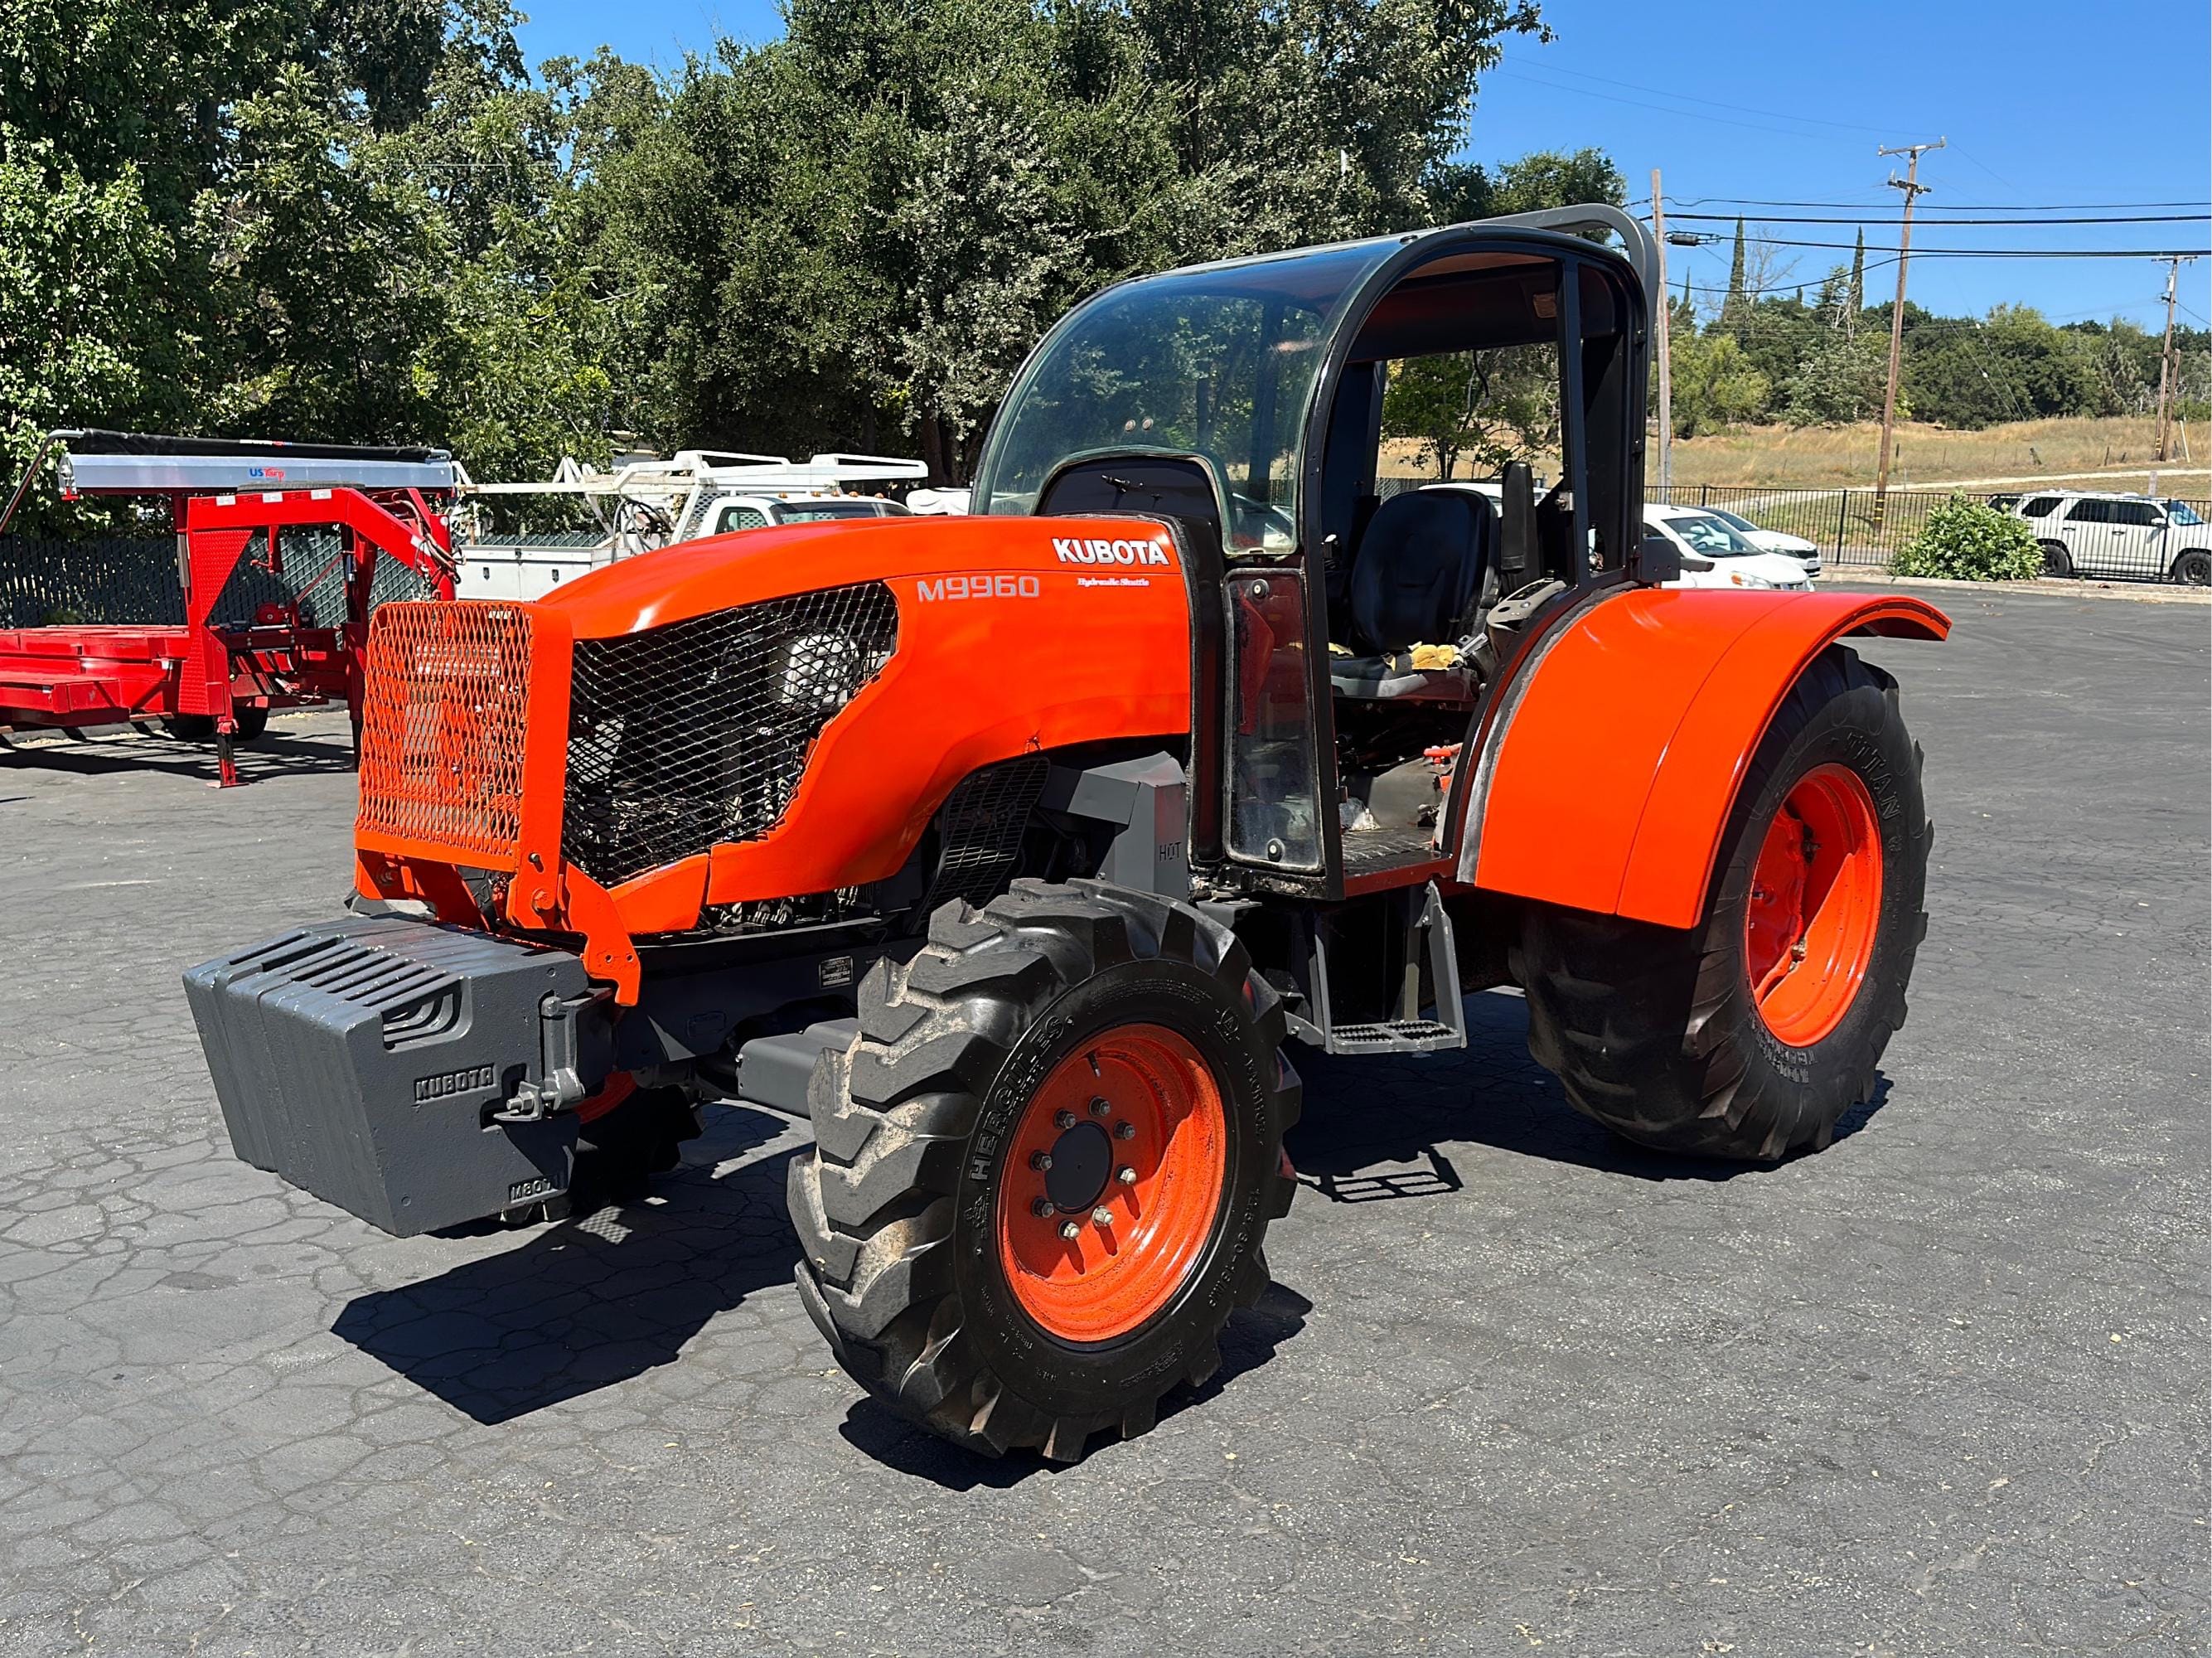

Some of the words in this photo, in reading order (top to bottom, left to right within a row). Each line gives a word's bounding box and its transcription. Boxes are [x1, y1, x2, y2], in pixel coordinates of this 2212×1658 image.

[1052, 538, 1169, 565] KUBOTA
[917, 575, 1039, 602] M9960
[1077, 578, 1120, 587] Hydraulic
[1121, 578, 1150, 587] Shuttle
[1846, 732, 1902, 821] TITAN
[1159, 841, 1182, 862] HOT
[415, 1066, 494, 1101] KUBOTA
